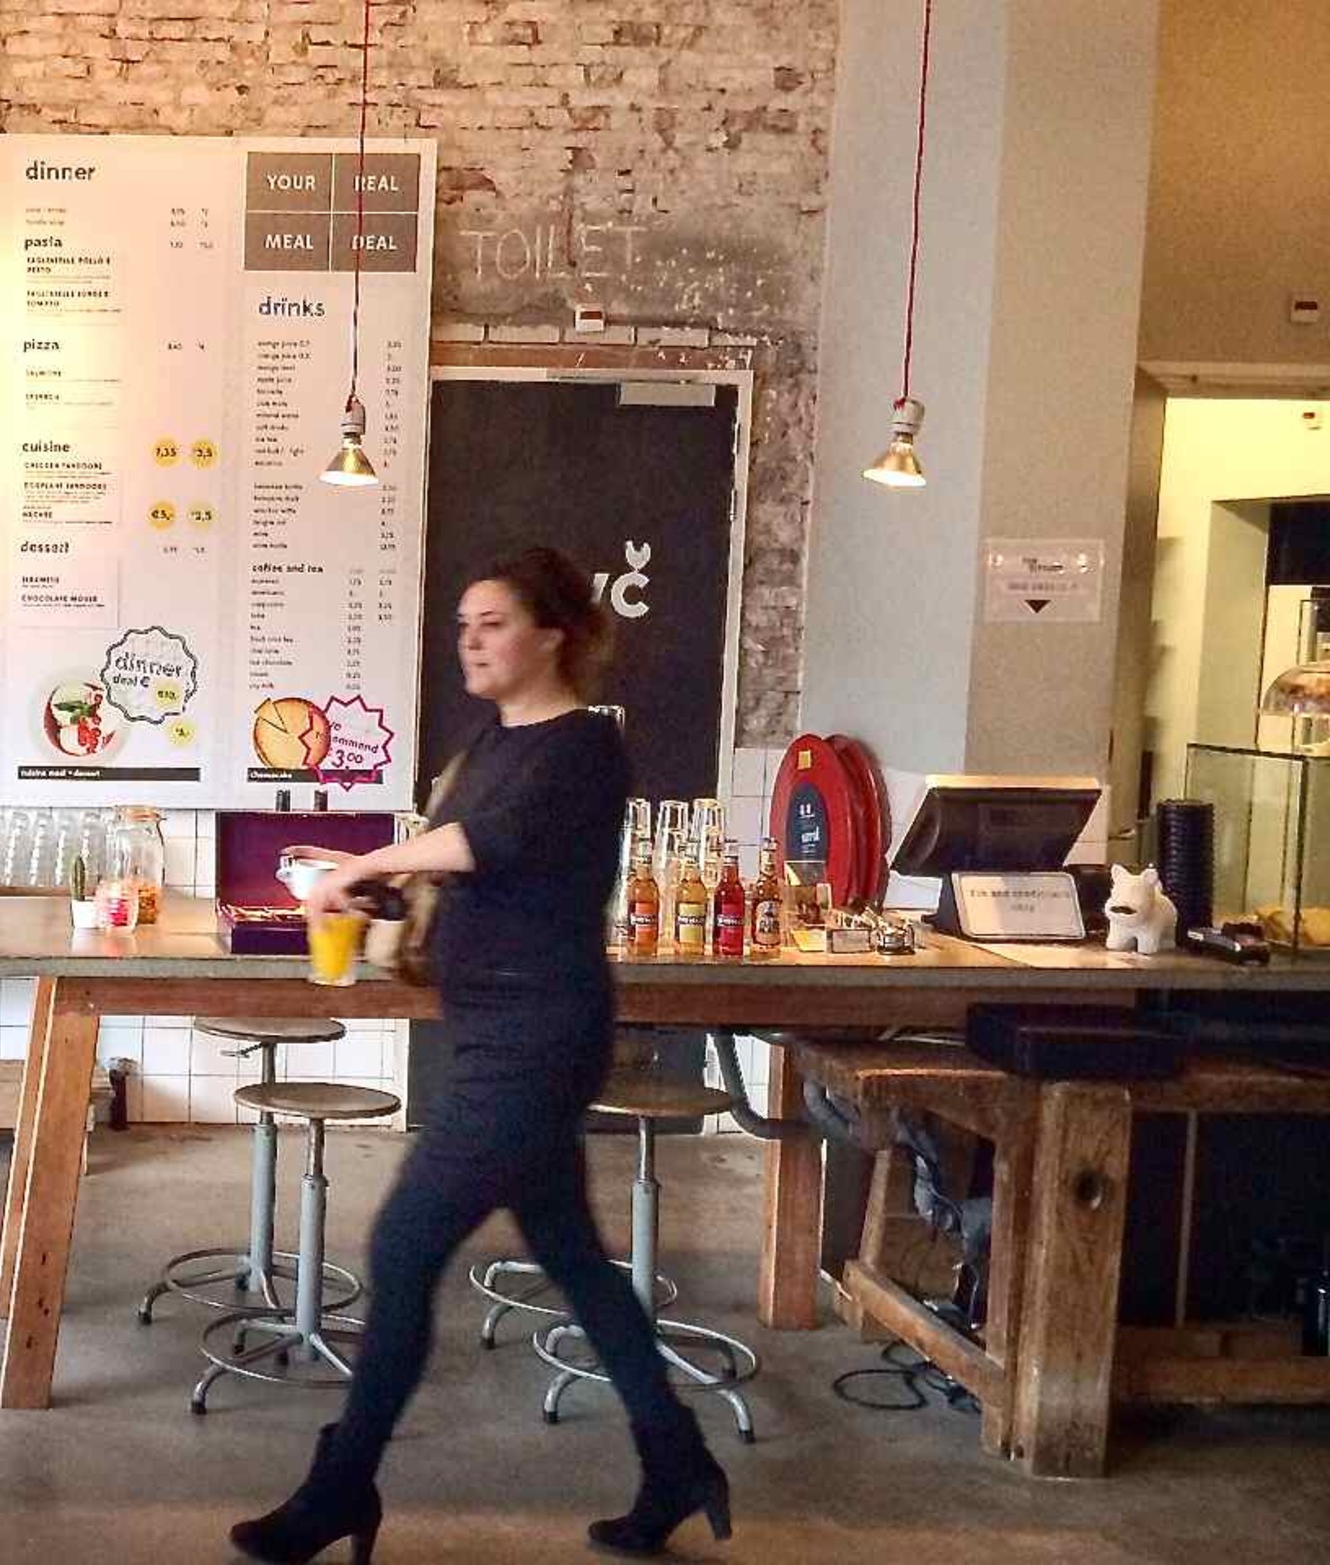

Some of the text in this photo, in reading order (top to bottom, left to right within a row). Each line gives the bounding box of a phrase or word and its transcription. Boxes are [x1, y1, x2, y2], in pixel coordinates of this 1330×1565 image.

[25, 160, 96, 181] dinner
[267, 175, 316, 190] YOUR
[24, 236, 63, 250] pasta
[265, 234, 398, 250] MEAL DEAL
[460, 221, 647, 280] TOILET
[258, 296, 326, 317] drinks
[23, 339, 60, 353] pizza
[22, 440, 71, 453] cuisine
[20, 541, 70, 554] dessert
[252, 563, 324, 574] coffee and tea
[115, 652, 182, 677] dinner
[113, 674, 139, 686] deal
